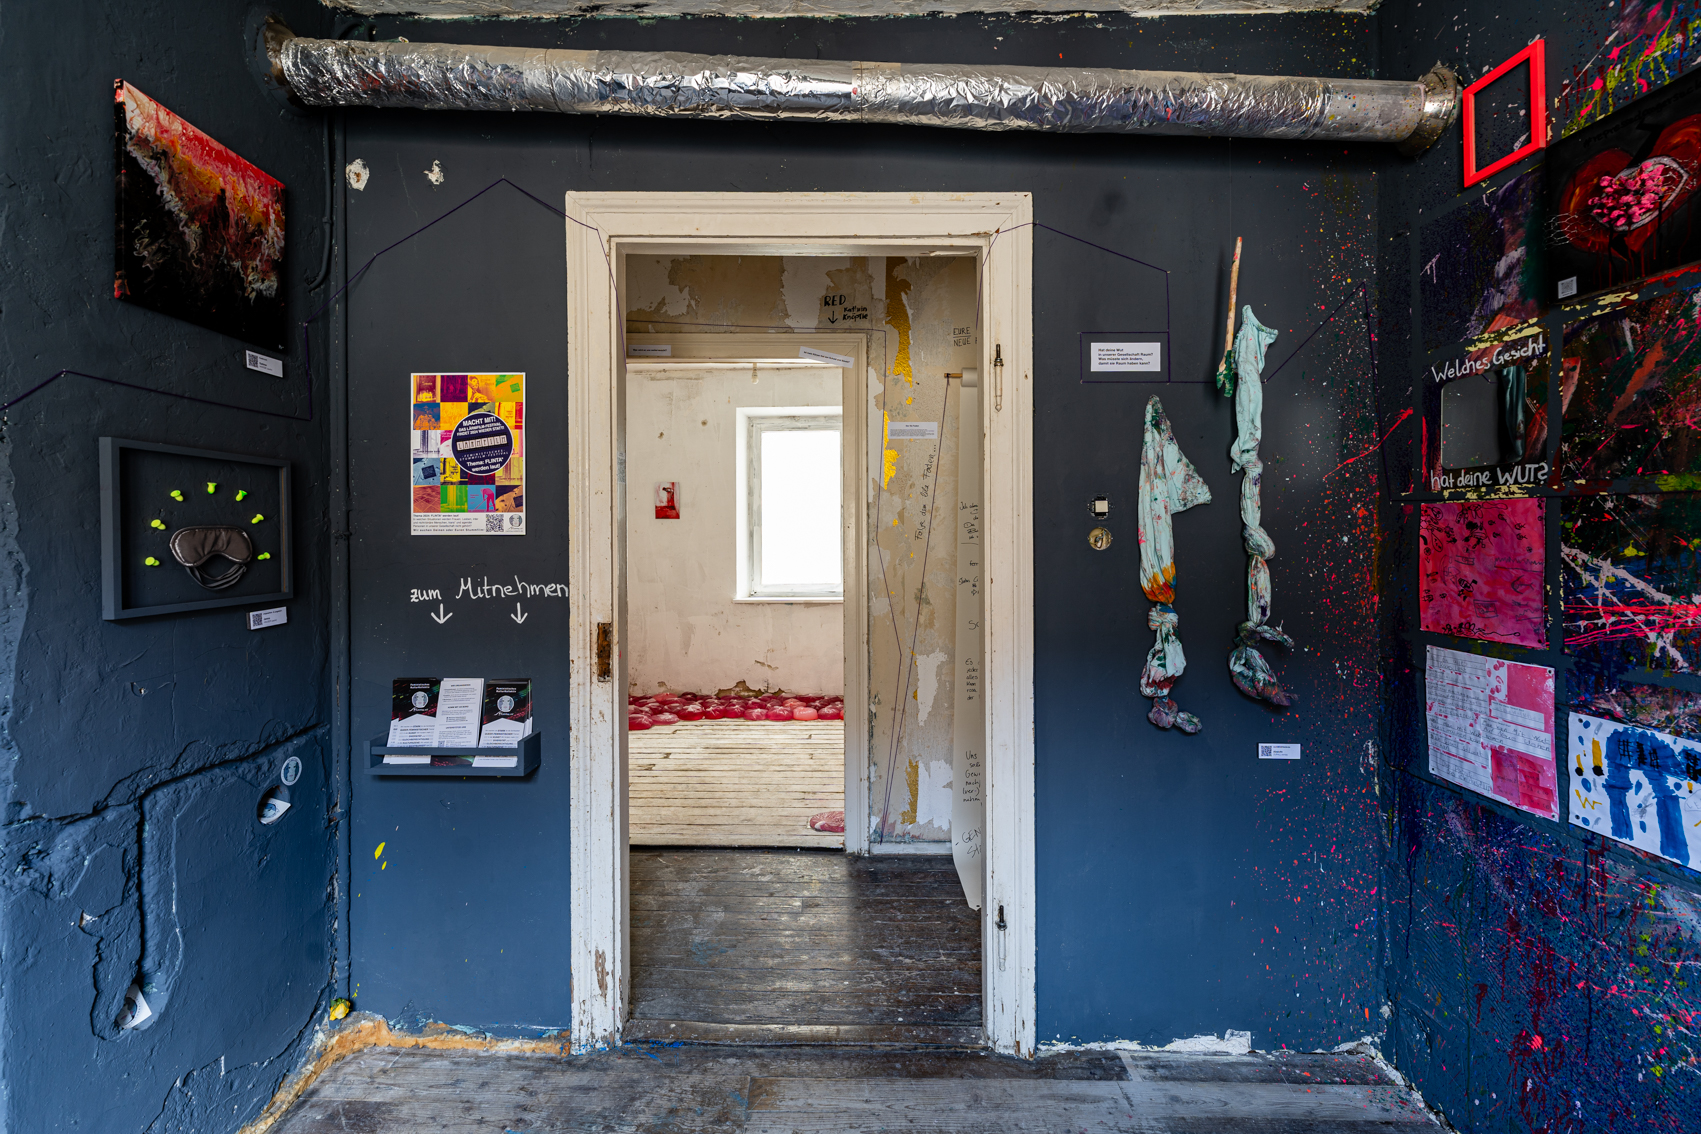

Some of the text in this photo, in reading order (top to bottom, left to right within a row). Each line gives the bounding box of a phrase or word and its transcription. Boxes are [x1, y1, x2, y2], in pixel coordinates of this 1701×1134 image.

[824, 294, 846, 307] RED
[953, 326, 971, 336] EURE
[954, 338, 971, 347] NEUE
[1431, 332, 1546, 382] Welches Gesicht
[1430, 462, 1549, 490] hat deine WUT?
[410, 575, 569, 602] zum Mitnehmen
